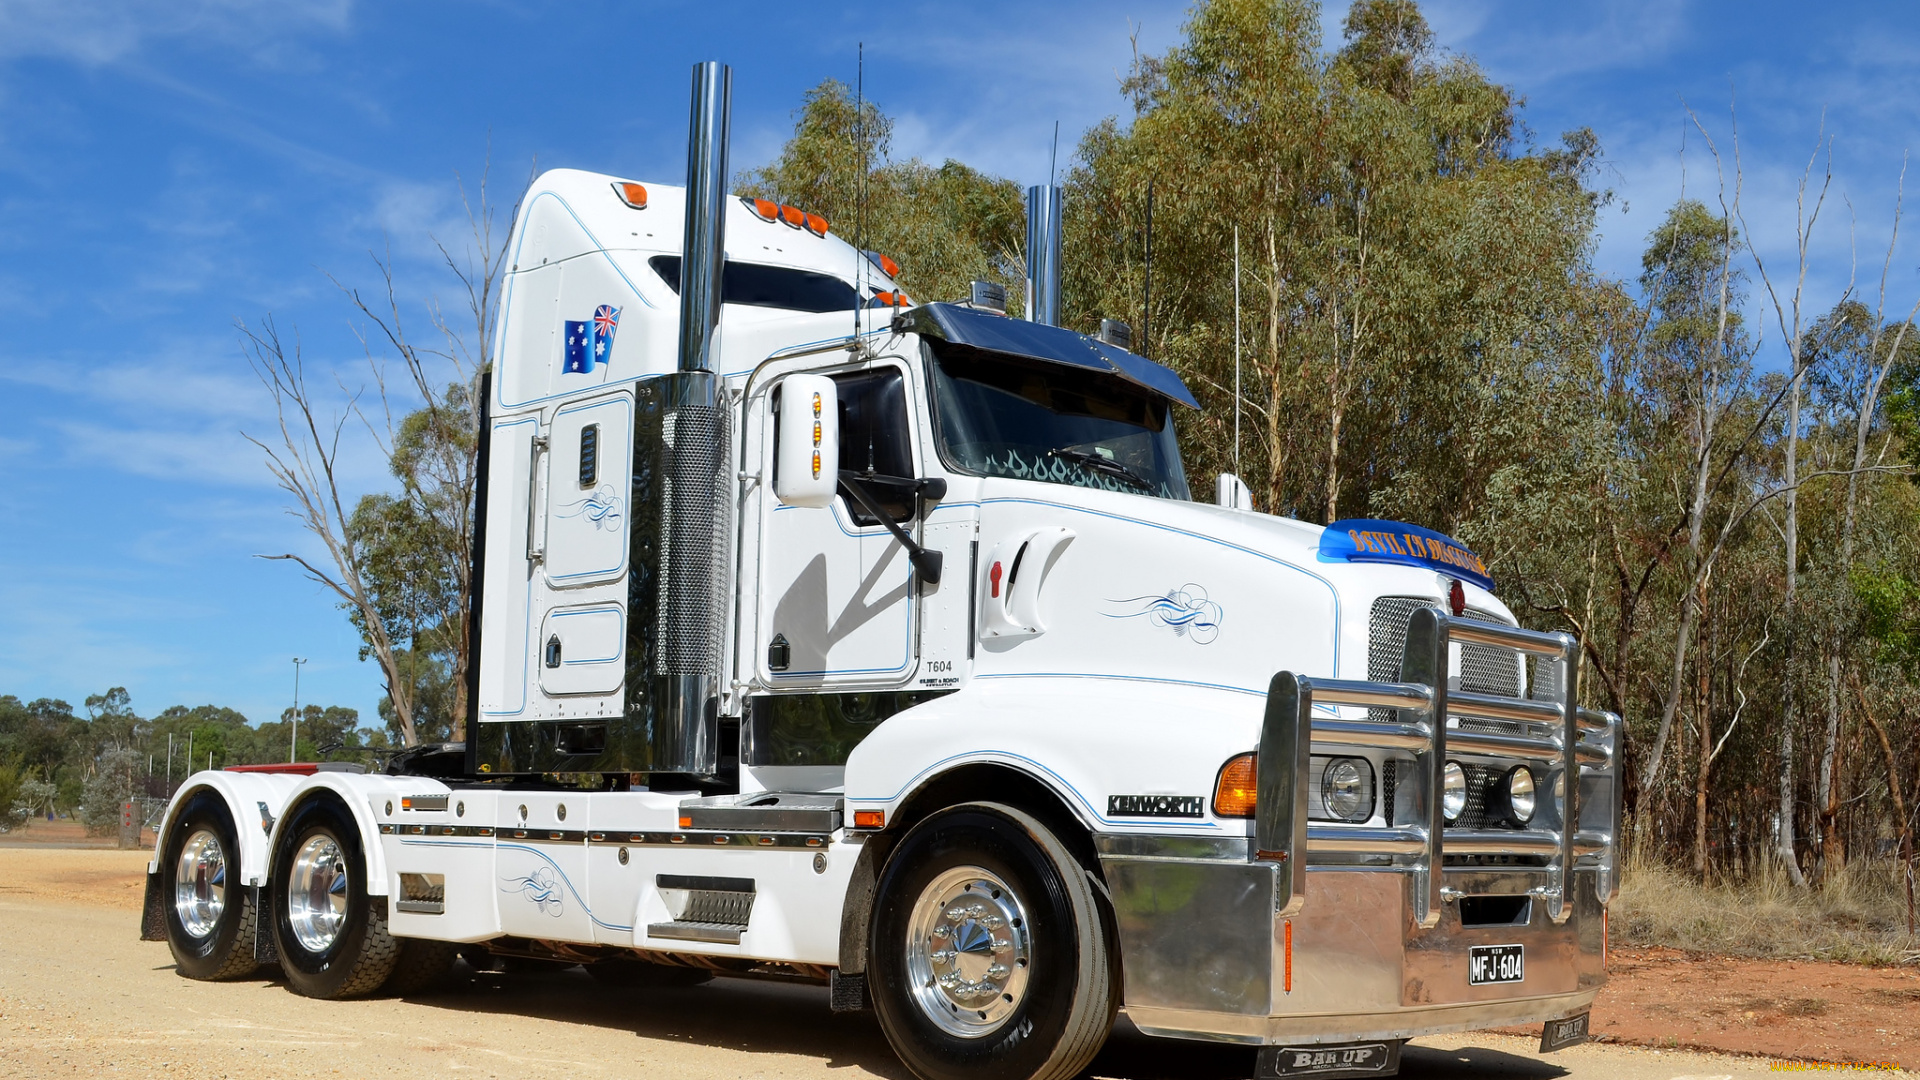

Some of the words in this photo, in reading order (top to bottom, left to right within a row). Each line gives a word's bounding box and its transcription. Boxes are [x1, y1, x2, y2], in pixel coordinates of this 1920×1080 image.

[1348, 529, 1406, 555] DEVIL
[1403, 534, 1427, 558] IN
[1426, 537, 1490, 578] DISGUISE
[927, 661, 952, 672] T604
[1108, 795, 1205, 816] KENWORTH
[1292, 1052, 1337, 1067] BAR
[1343, 1049, 1373, 1063] UP
